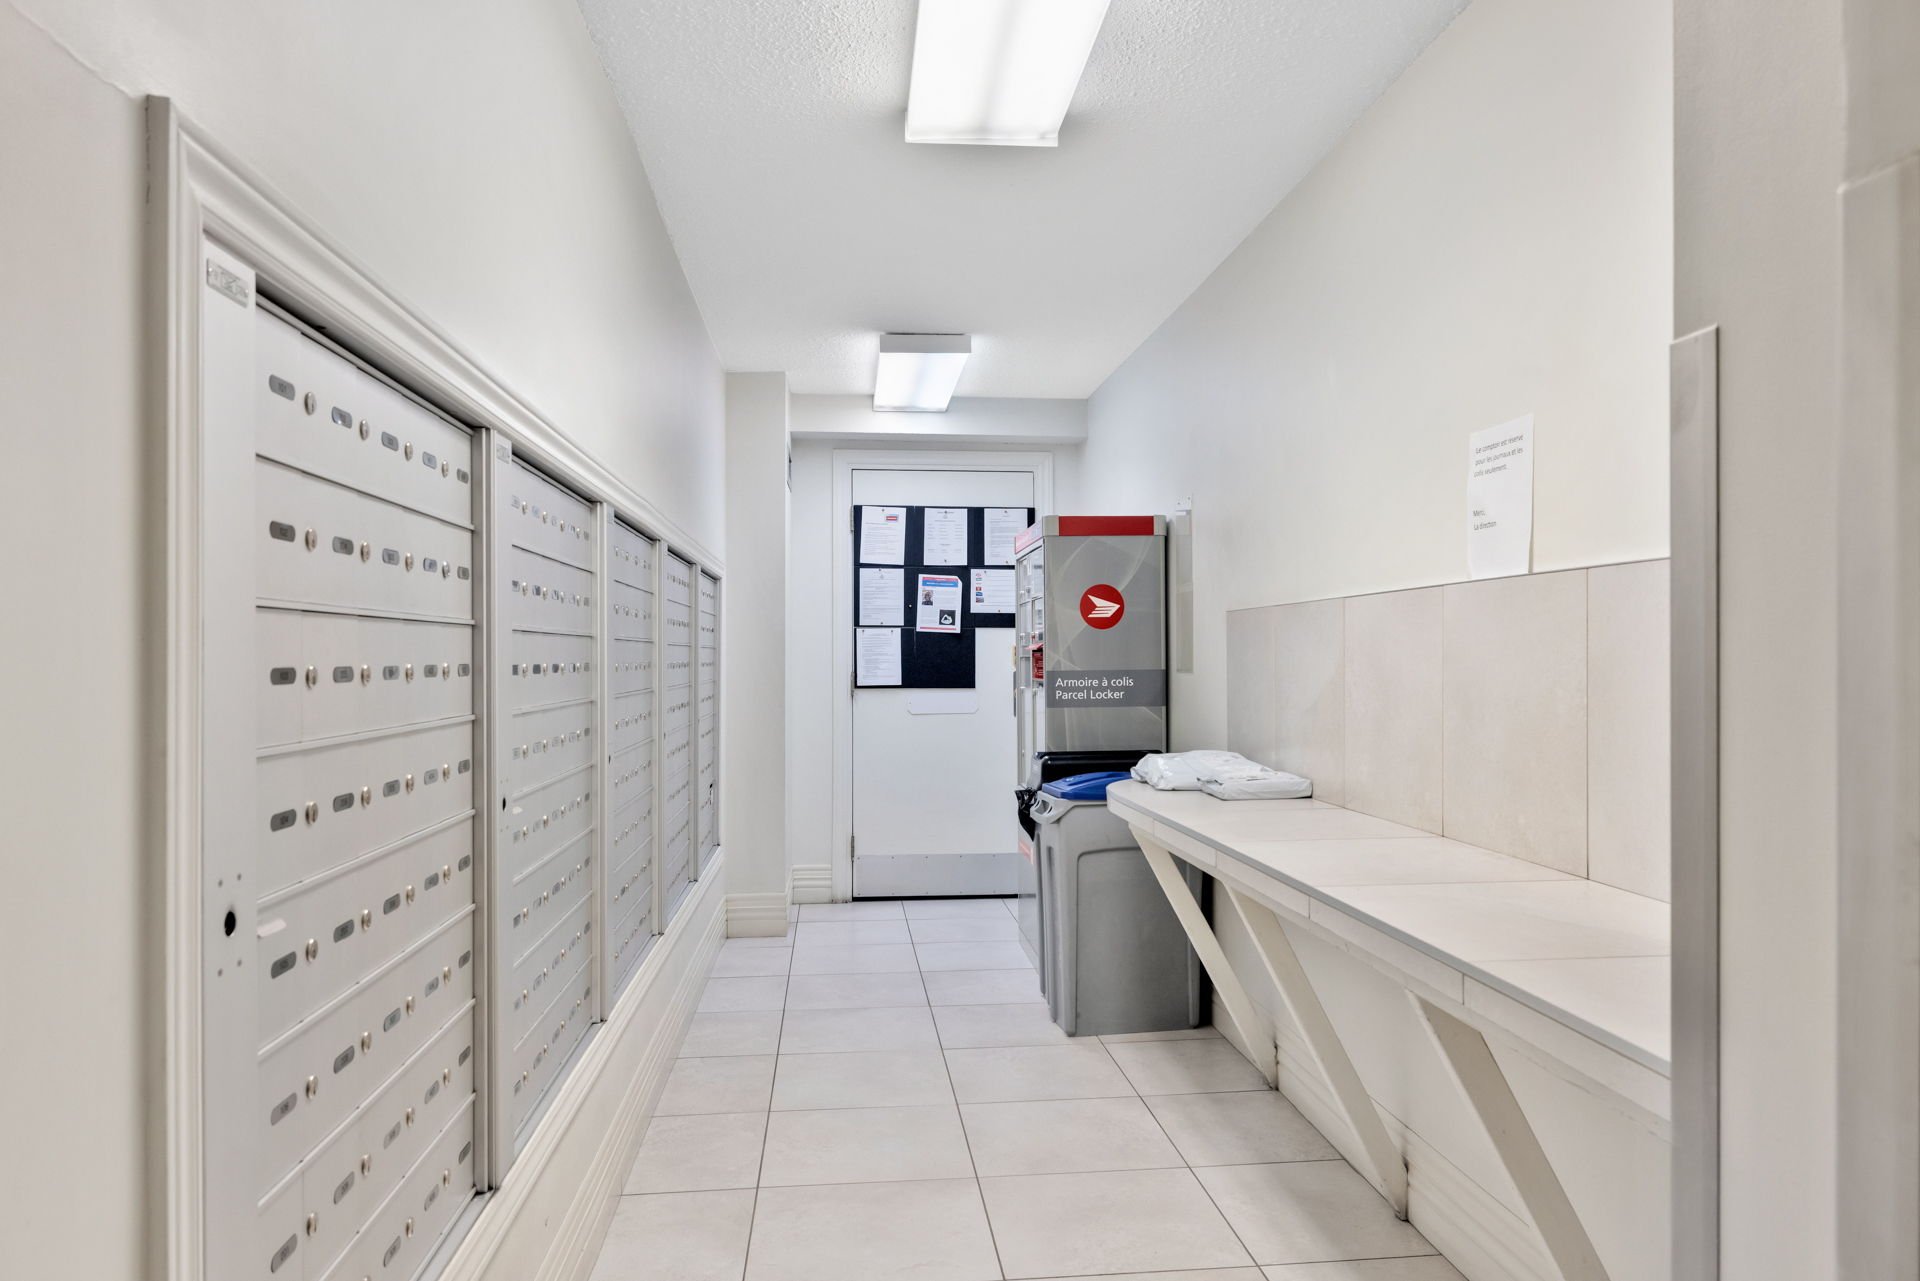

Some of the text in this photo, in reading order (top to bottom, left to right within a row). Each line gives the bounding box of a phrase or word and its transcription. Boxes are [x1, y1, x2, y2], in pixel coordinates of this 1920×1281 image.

[1055, 676, 1134, 687] Armoire à colis
[1055, 689, 1125, 700] Parcel Locker
